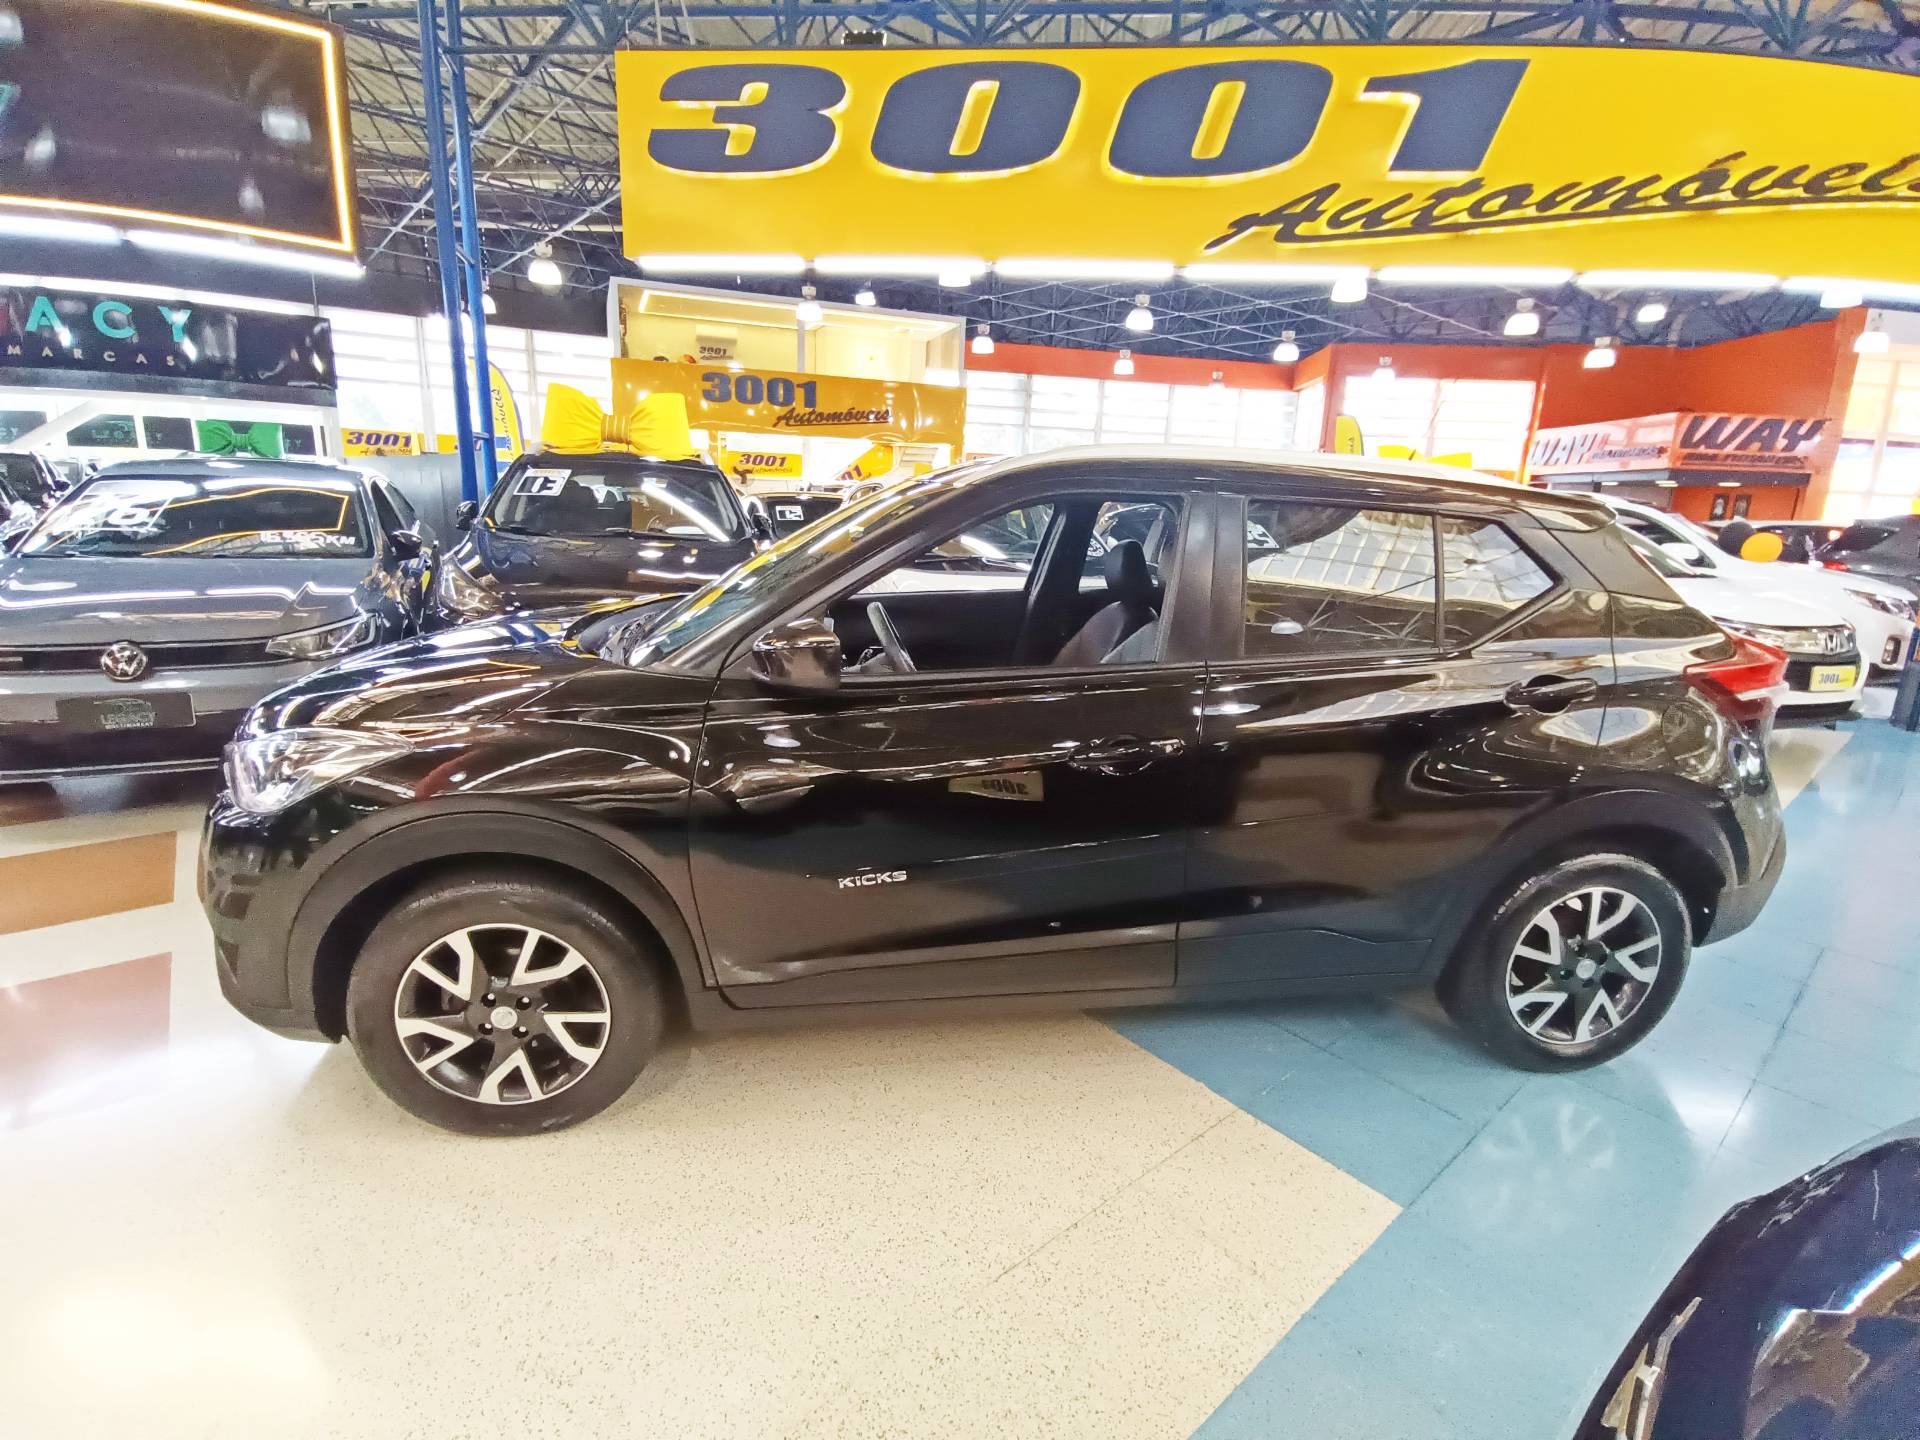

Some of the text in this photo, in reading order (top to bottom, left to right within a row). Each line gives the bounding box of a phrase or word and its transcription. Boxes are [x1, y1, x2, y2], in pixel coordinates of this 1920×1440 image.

[648, 60, 1531, 175] 3001
[1204, 151, 1920, 251] Automóvei
[7, 344, 175, 366] MARCAS
[702, 372, 817, 408] 3001
[772, 407, 892, 427] Automóveis
[346, 431, 411, 448] 3001
[1680, 416, 1828, 452] WAY
[740, 453, 787, 467] 3001
[1531, 434, 1598, 466] WAY
[837, 870, 907, 889] KICKS
